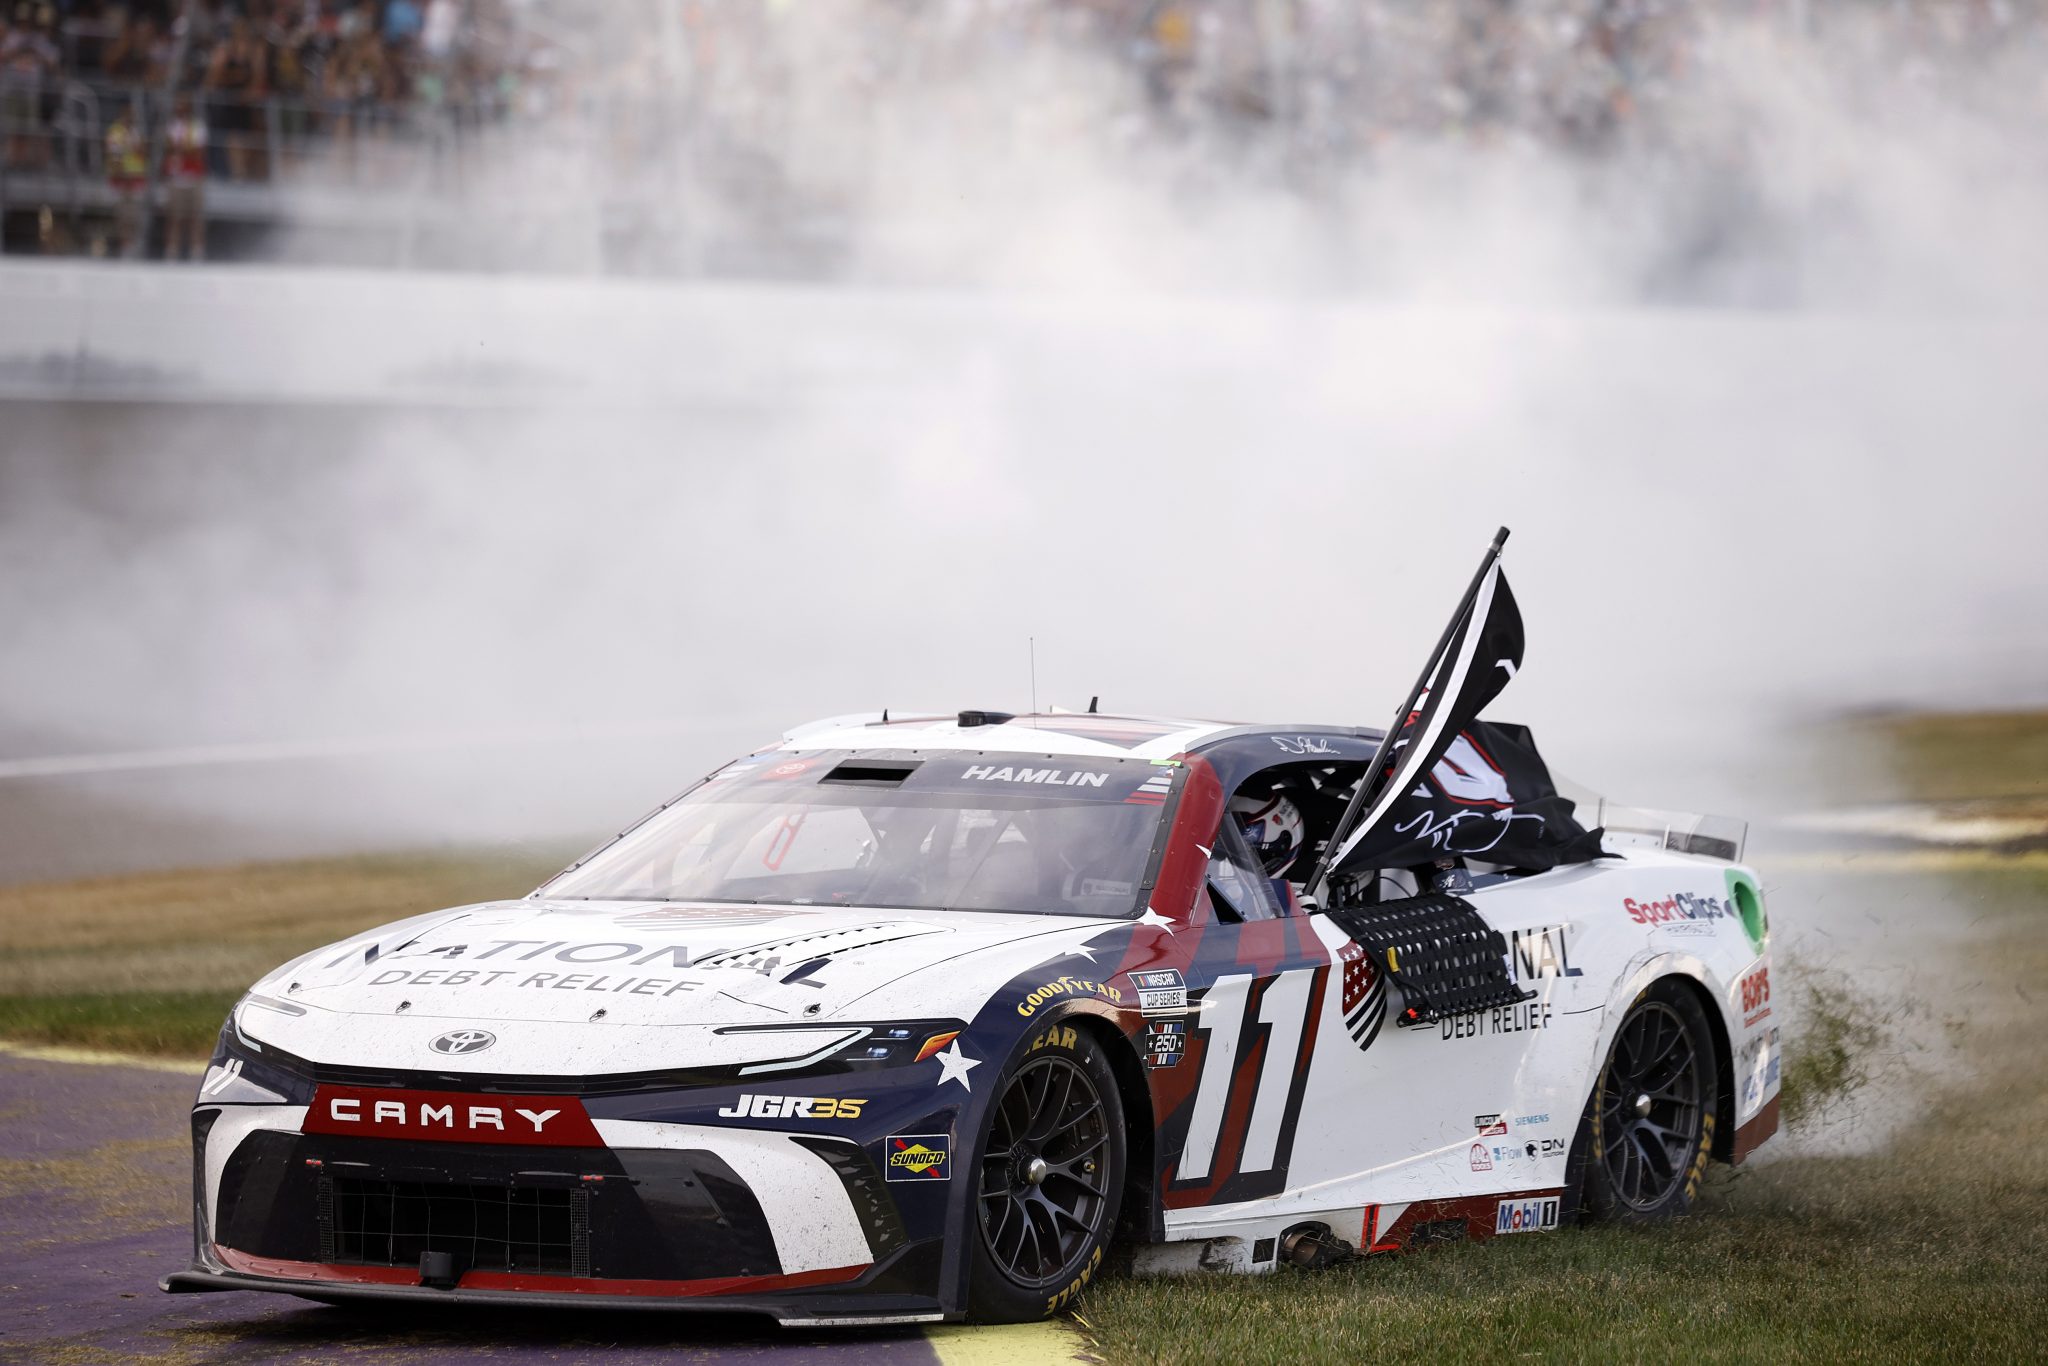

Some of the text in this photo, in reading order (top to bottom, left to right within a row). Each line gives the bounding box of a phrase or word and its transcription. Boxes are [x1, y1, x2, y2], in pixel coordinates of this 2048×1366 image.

[961, 765, 1109, 787] HAMLIN
[1511, 924, 1583, 980] NAL
[368, 970, 704, 996] DEBT RELIEF
[1147, 973, 1175, 986] NASCAR
[1017, 976, 1122, 1017] GOODYEAR
[1147, 991, 1181, 1006] CUP SERIES
[1442, 1003, 1552, 1040] DEBT RELIEF
[1024, 1024, 1078, 1056] EAR
[1155, 1035, 1177, 1052] 250
[1176, 968, 1315, 1181] 11
[331, 1098, 561, 1132] CAMRY
[1515, 1114, 1550, 1126] SIEMENS
[1541, 1138, 1565, 1151] DN
[892, 1151, 945, 1167] SUNOCO
[1498, 1202, 1541, 1230] Mobil
